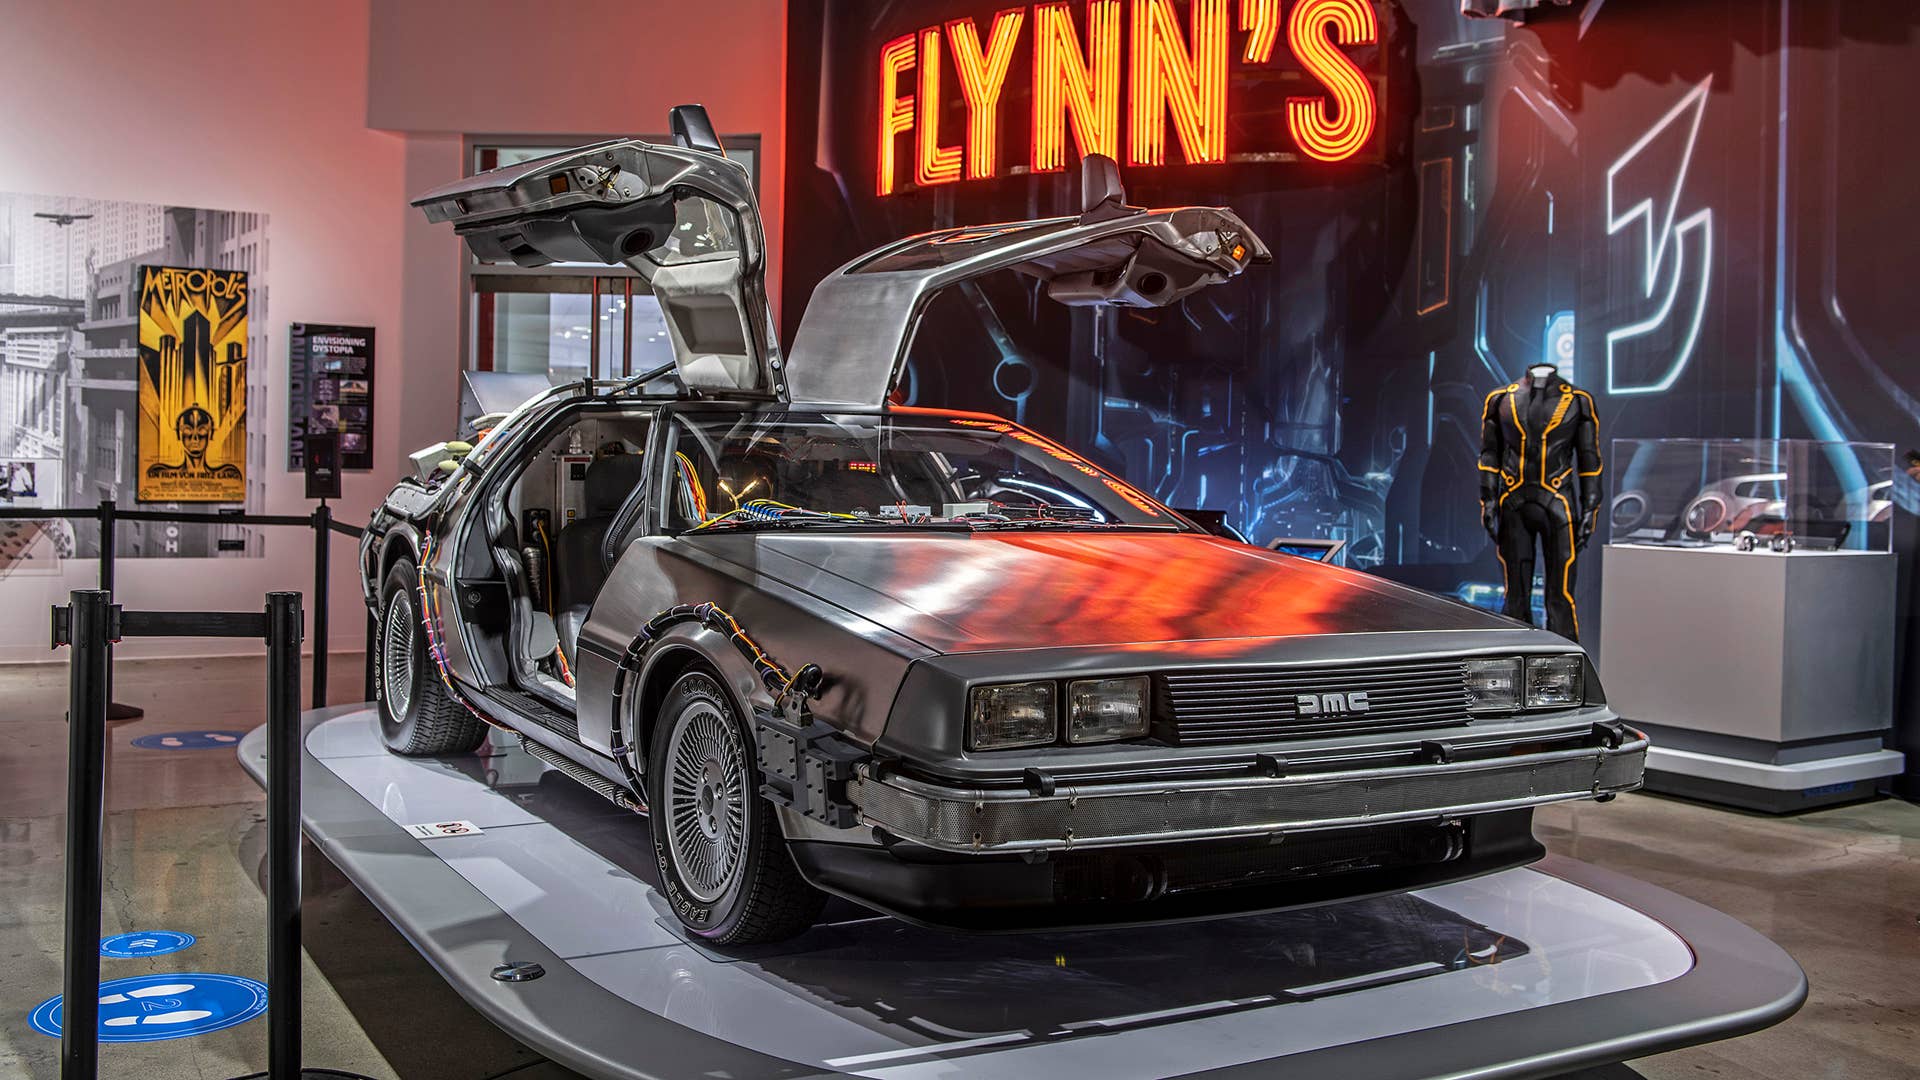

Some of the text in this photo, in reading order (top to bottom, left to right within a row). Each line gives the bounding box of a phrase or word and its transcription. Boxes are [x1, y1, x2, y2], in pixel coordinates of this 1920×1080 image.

[876, 0, 1379, 196] FLYNN'S
[312, 335, 366, 347] ENVISIONING
[312, 344, 354, 354] DYSTOPIA
[669, 881, 708, 922] EAGLE
